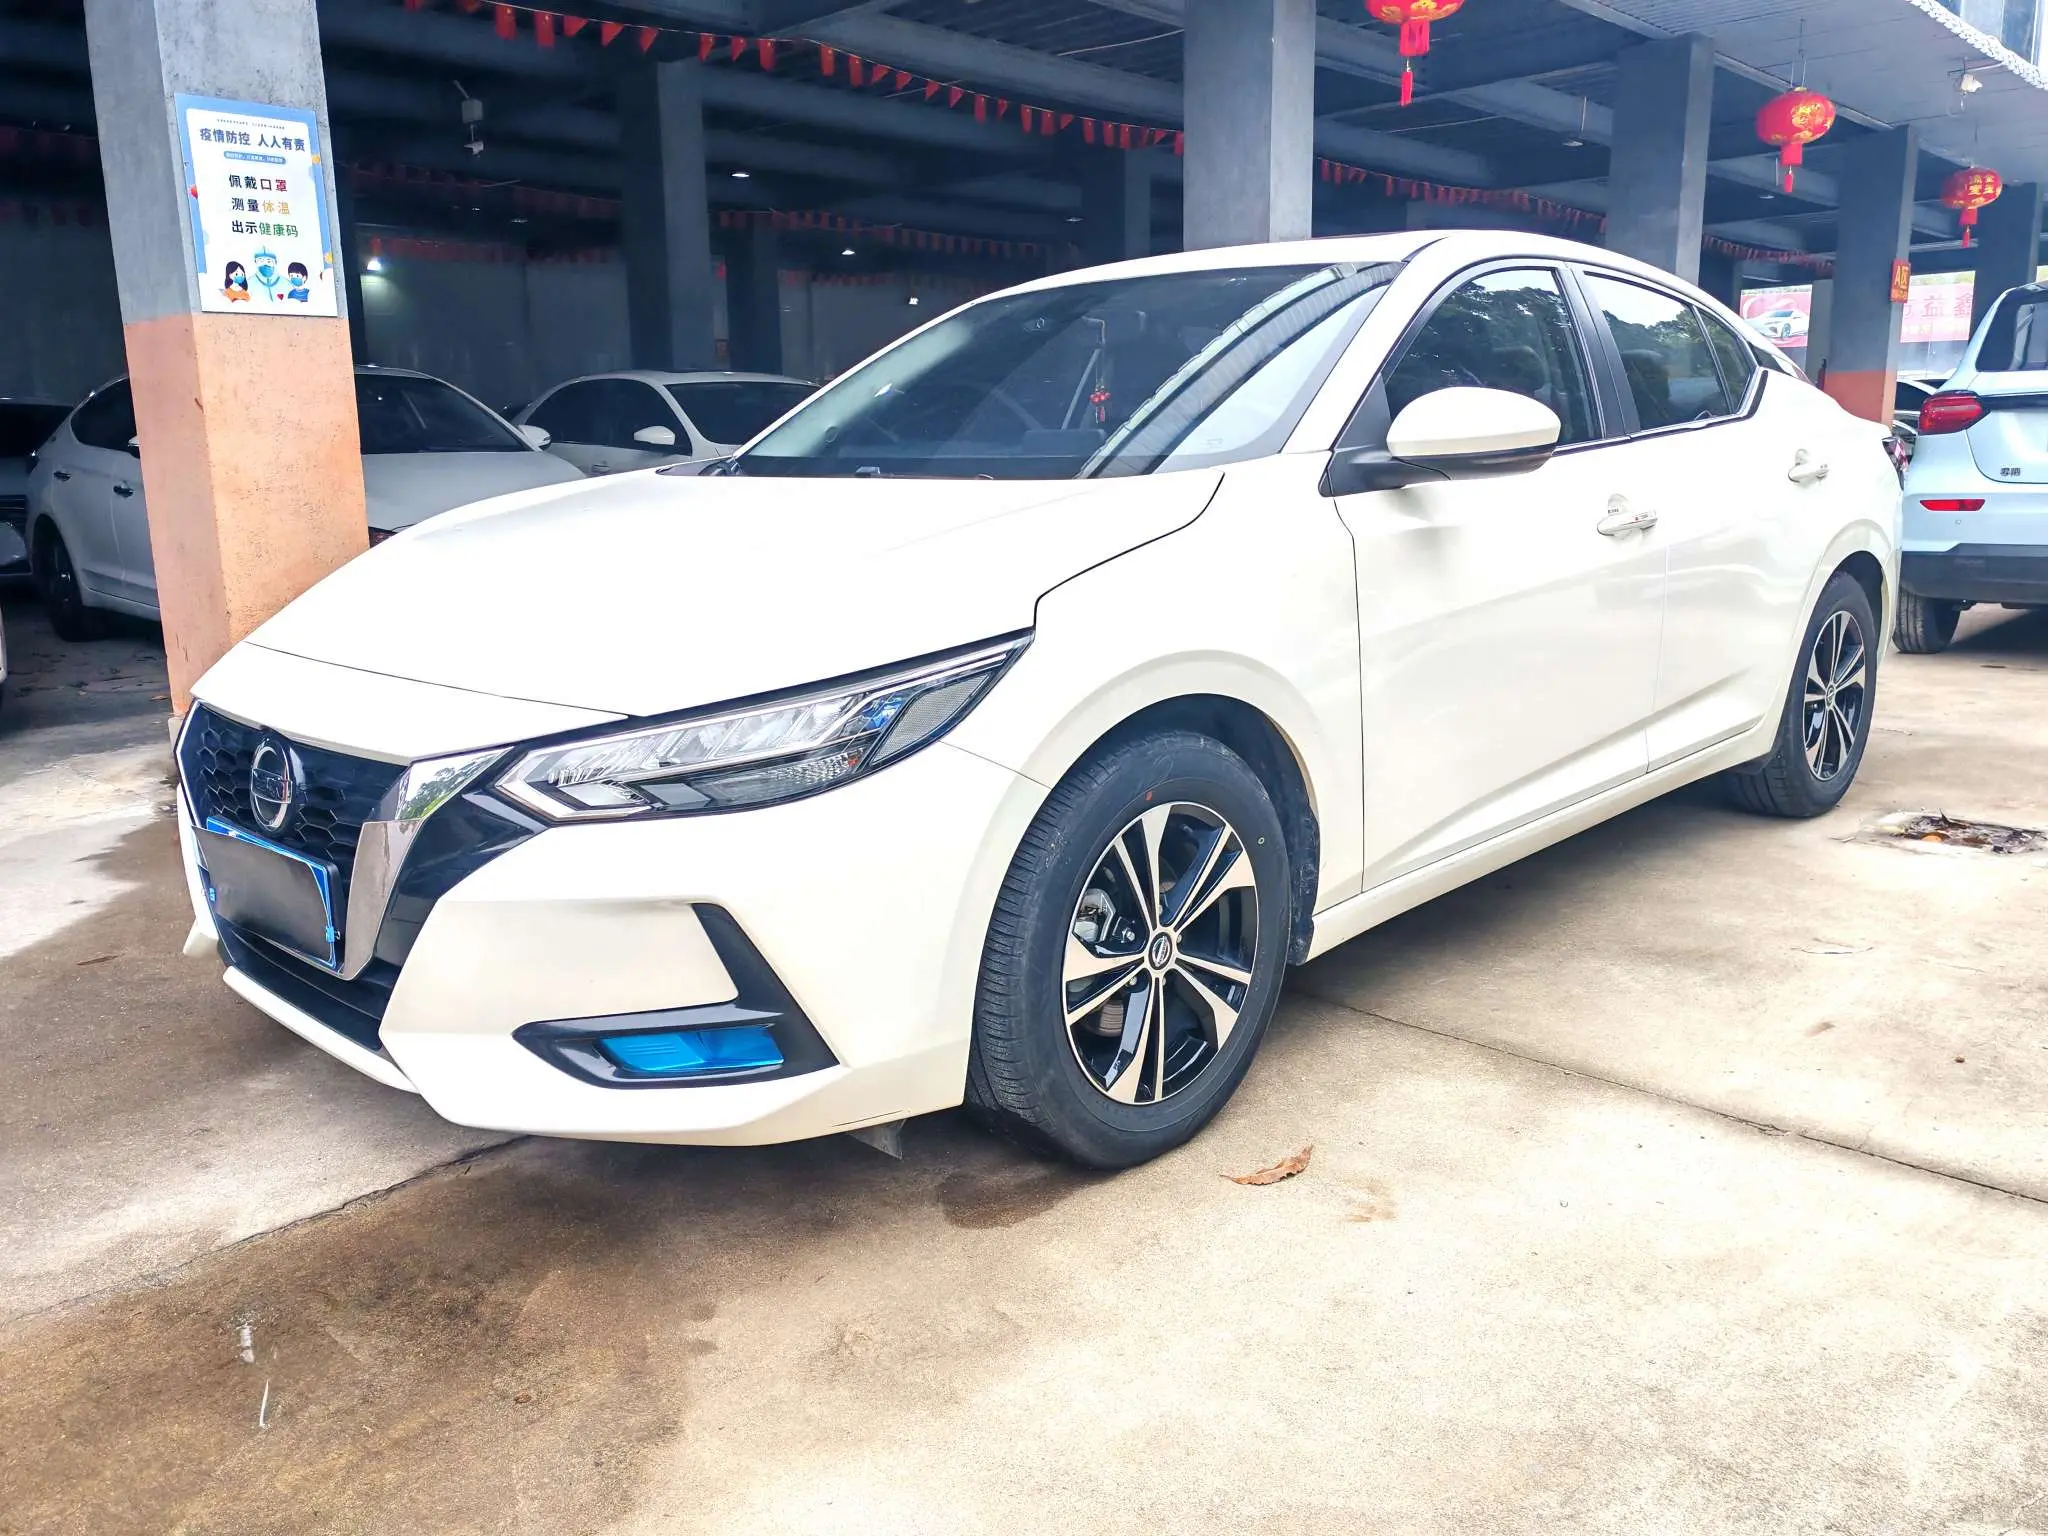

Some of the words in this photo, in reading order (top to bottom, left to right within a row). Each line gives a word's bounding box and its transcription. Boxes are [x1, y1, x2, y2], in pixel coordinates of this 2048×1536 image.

[200, 128, 251, 146] 疫情防控
[258, 134, 305, 152] 人人有责
[229, 174, 288, 192] 佩戴口罩
[231, 197, 290, 215] 测量体温
[232, 220, 299, 238] 出示健康码
